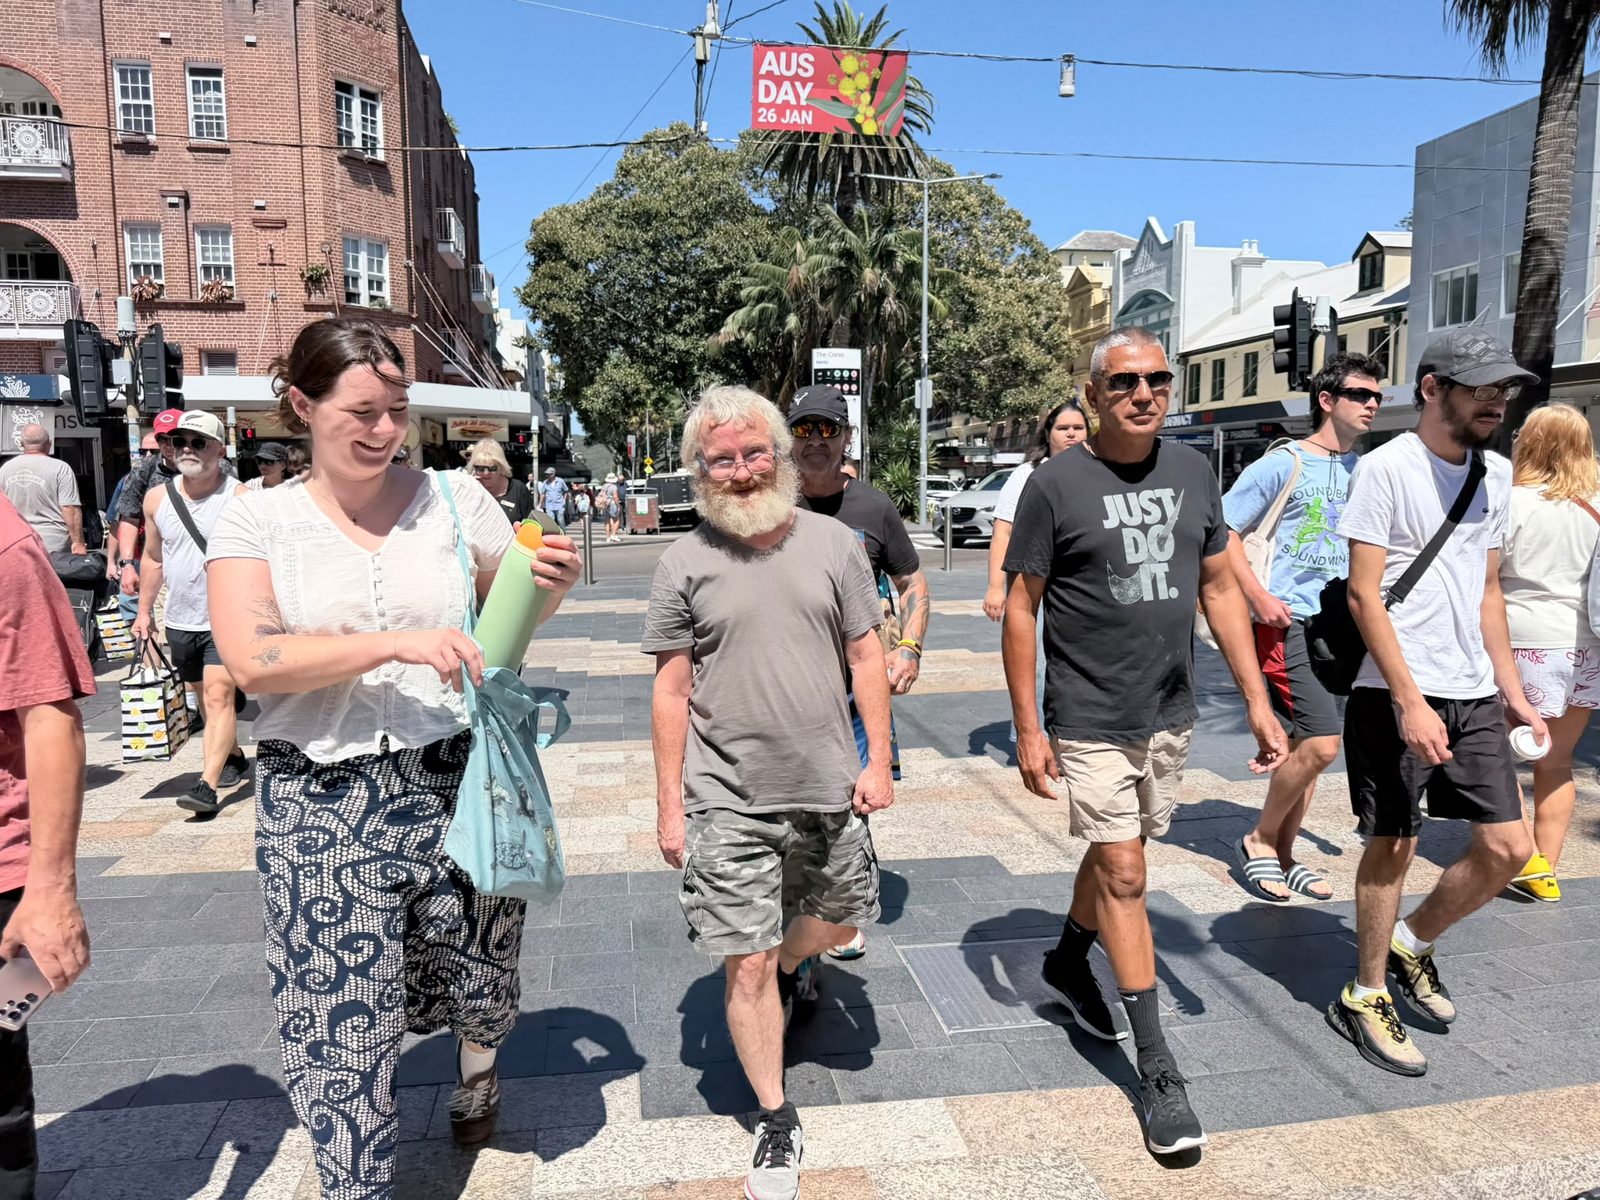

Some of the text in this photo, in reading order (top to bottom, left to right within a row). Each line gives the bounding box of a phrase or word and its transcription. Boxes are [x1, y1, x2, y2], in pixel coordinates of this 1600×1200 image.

[759, 51, 815, 78] AUS
[758, 79, 814, 106] DAY
[757, 108, 813, 125] 26 JAN
[1102, 487, 1176, 530] JUST
[1121, 524, 1175, 564] DO
[1281, 543, 1350, 566] SOUND MIN
[1138, 562, 1179, 602] IT.
